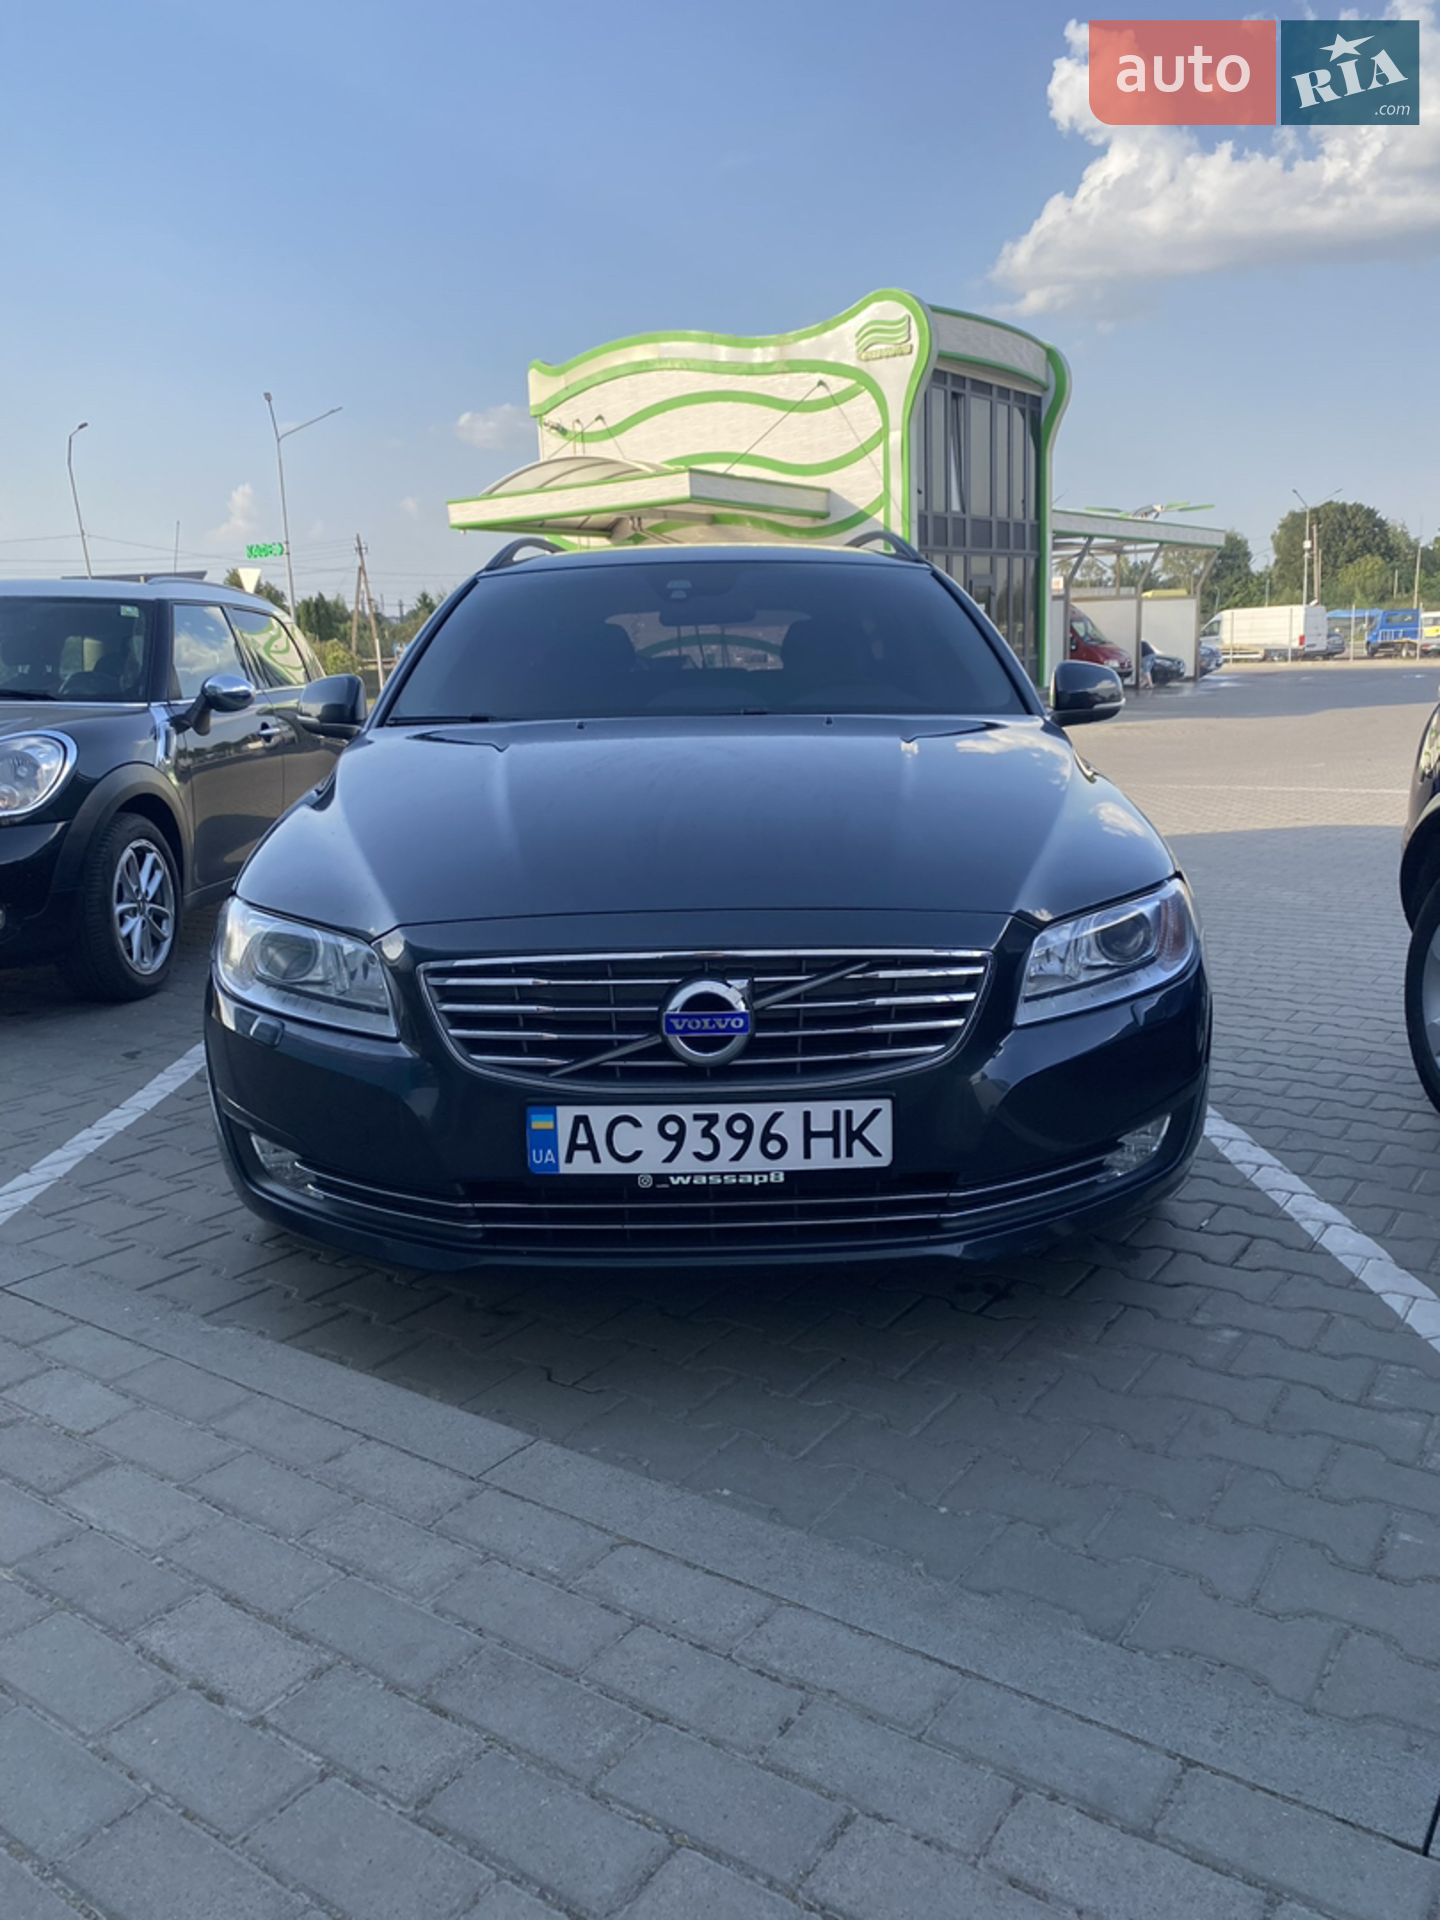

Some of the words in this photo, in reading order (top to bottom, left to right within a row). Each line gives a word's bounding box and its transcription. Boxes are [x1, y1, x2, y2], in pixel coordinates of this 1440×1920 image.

[669, 1017, 744, 1031] VOLVO
[564, 1114, 644, 1164] AC
[657, 1111, 789, 1164] 9396
[802, 1107, 883, 1160] HK
[532, 1148, 556, 1164] UA
